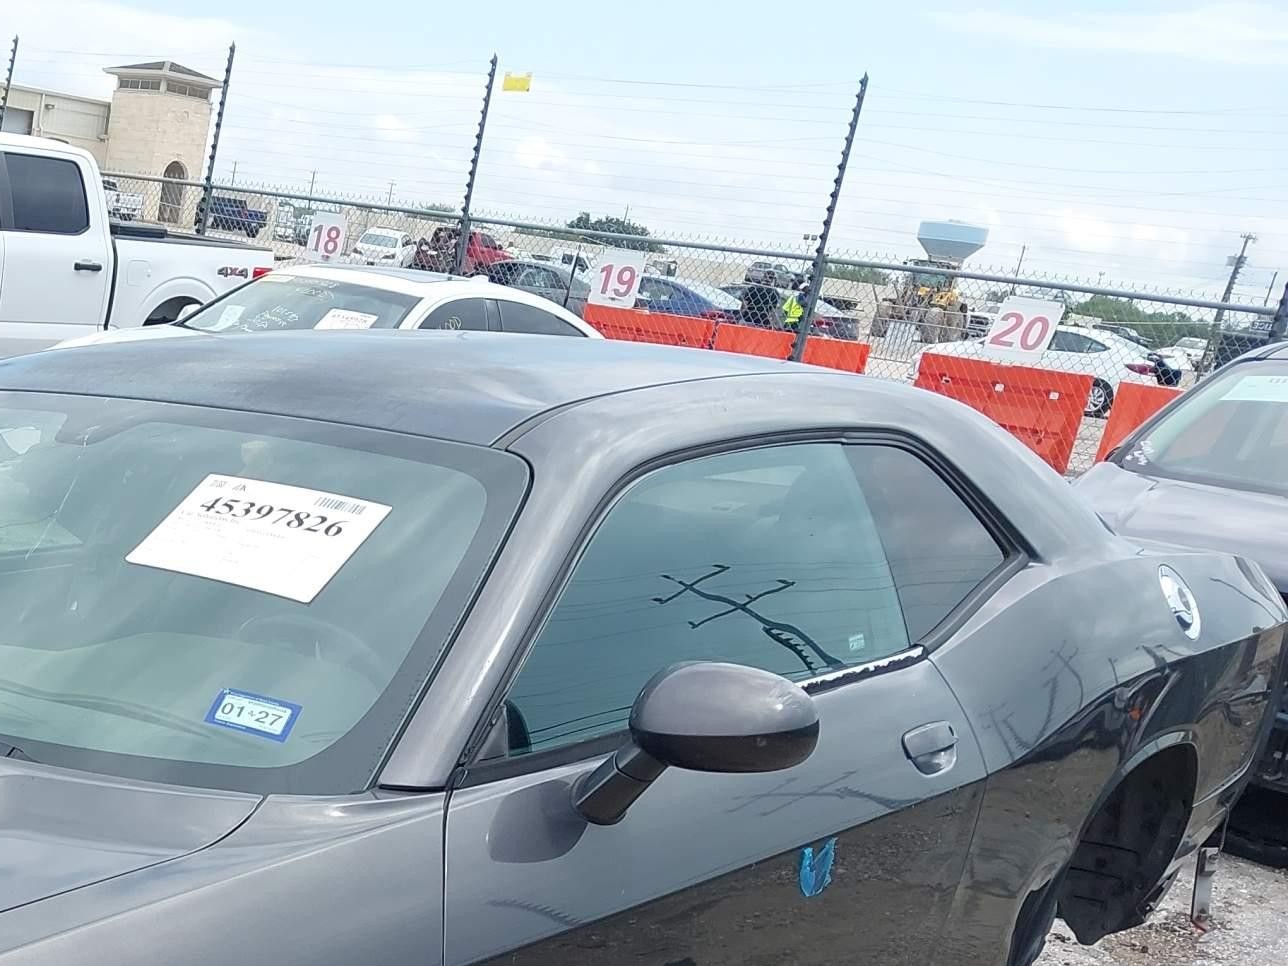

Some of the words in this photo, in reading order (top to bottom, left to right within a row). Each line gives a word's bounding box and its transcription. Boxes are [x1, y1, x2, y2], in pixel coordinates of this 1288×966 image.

[314, 224, 341, 254] 18
[600, 264, 636, 297] 19
[989, 312, 1049, 350] 20
[199, 496, 350, 537] 45397826
